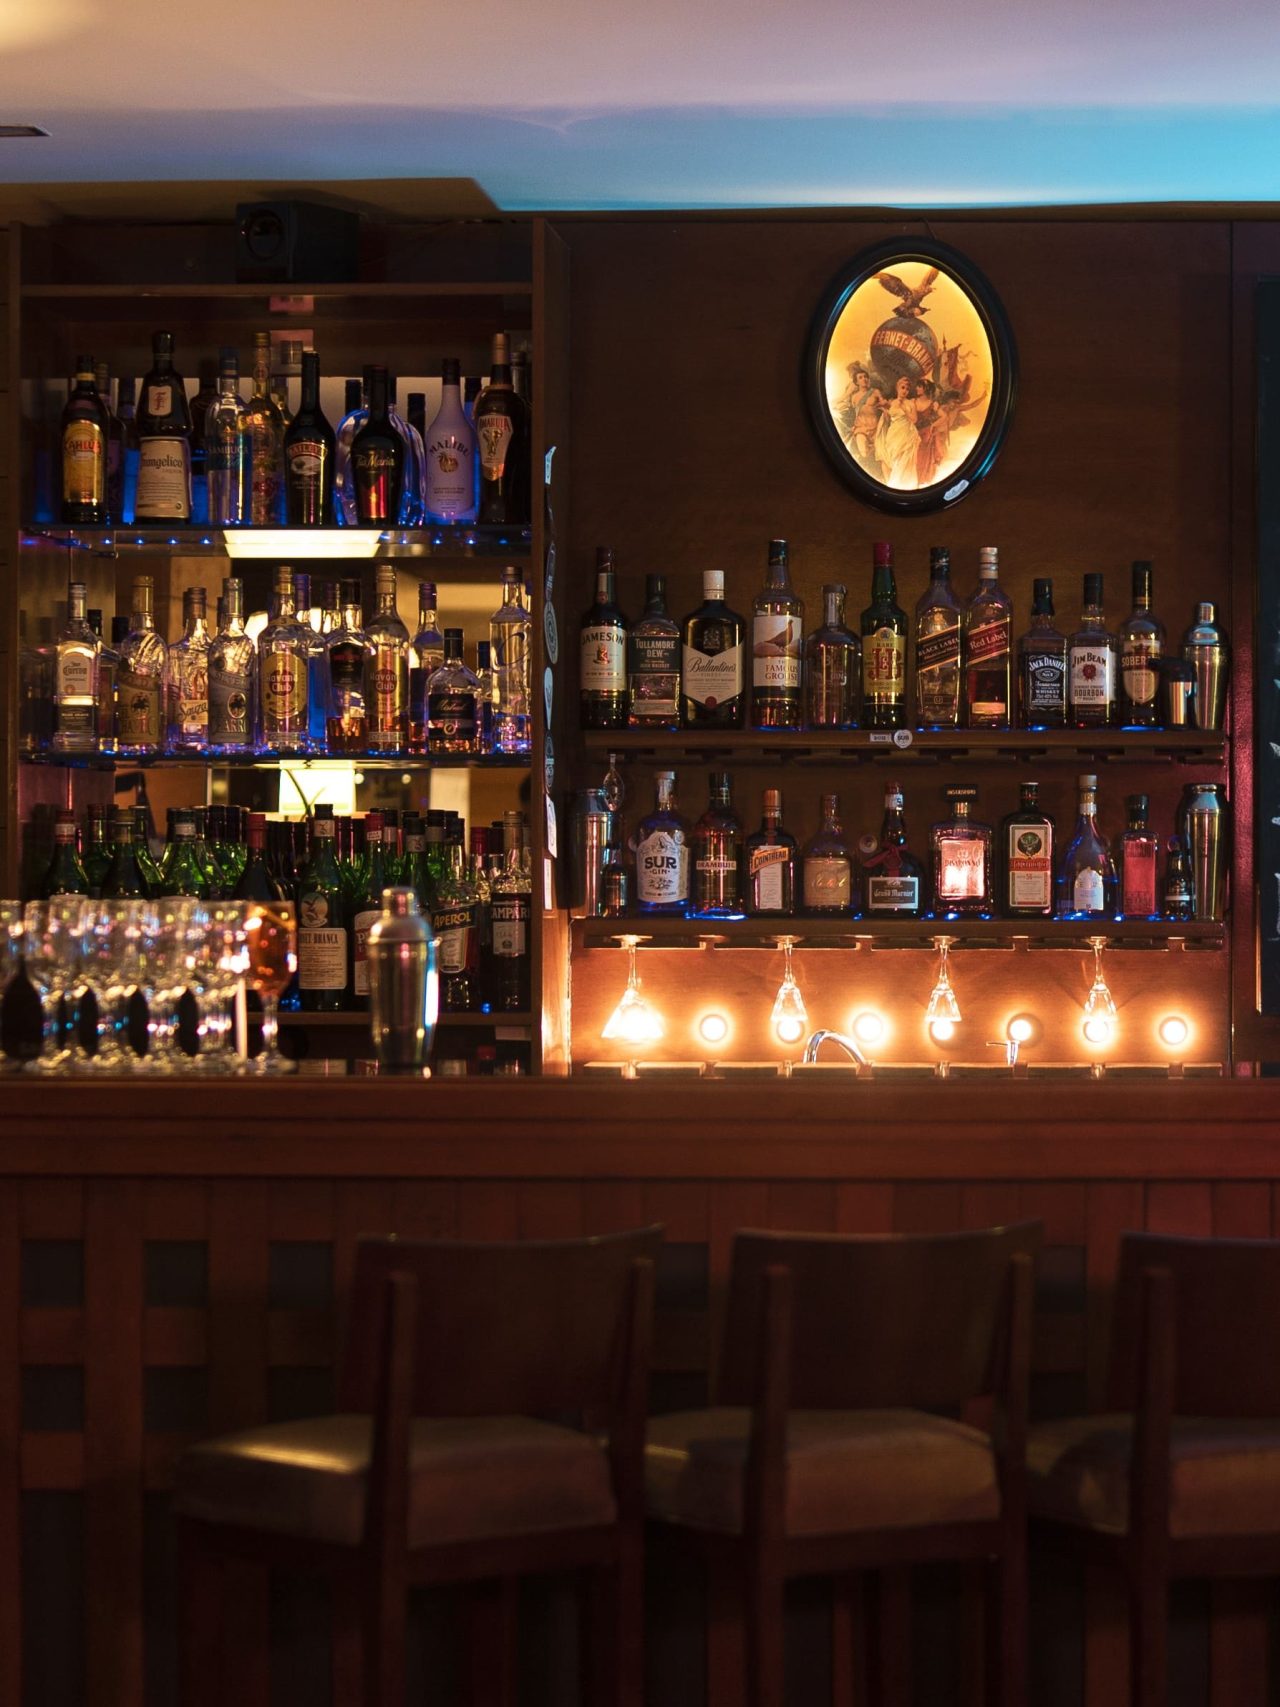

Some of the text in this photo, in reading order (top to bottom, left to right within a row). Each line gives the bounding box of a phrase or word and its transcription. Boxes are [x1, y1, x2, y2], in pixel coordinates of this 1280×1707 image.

[430, 440, 471, 457] MALIBU
[582, 631, 625, 646] JAMESON
[635, 638, 676, 650] TULLAMORE
[969, 630, 1007, 650] Red Label
[646, 650, 665, 658] DEW
[1072, 652, 1107, 668] JIM BEAM
[1121, 655, 1152, 667] SOBER
[765, 664, 798, 673] FAMOUS
[1028, 659, 1044, 672] JACK
[765, 673, 798, 681] GROUSE
[645, 855, 677, 870] SUR
[753, 850, 789, 869] COINTREAU
[433, 910, 473, 929] APEROL
